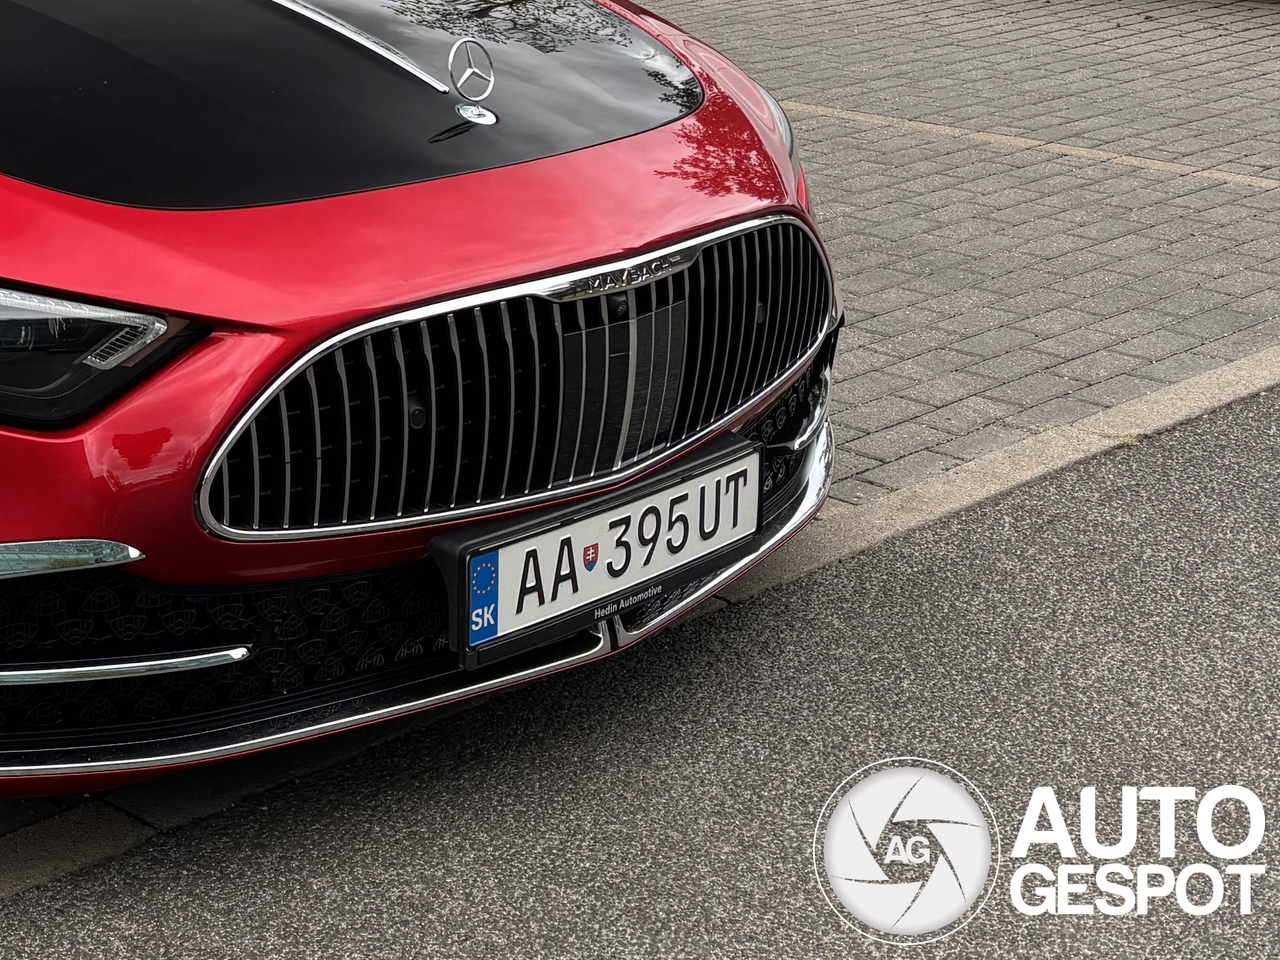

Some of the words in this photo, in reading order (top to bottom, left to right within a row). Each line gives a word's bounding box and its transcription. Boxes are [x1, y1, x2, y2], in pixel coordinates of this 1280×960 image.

[587, 255, 673, 294] MAYBACH
[515, 535, 580, 615] AA
[471, 603, 496, 632] SK
[594, 602, 618, 620] Hedin
[619, 584, 662, 610] Automotive
